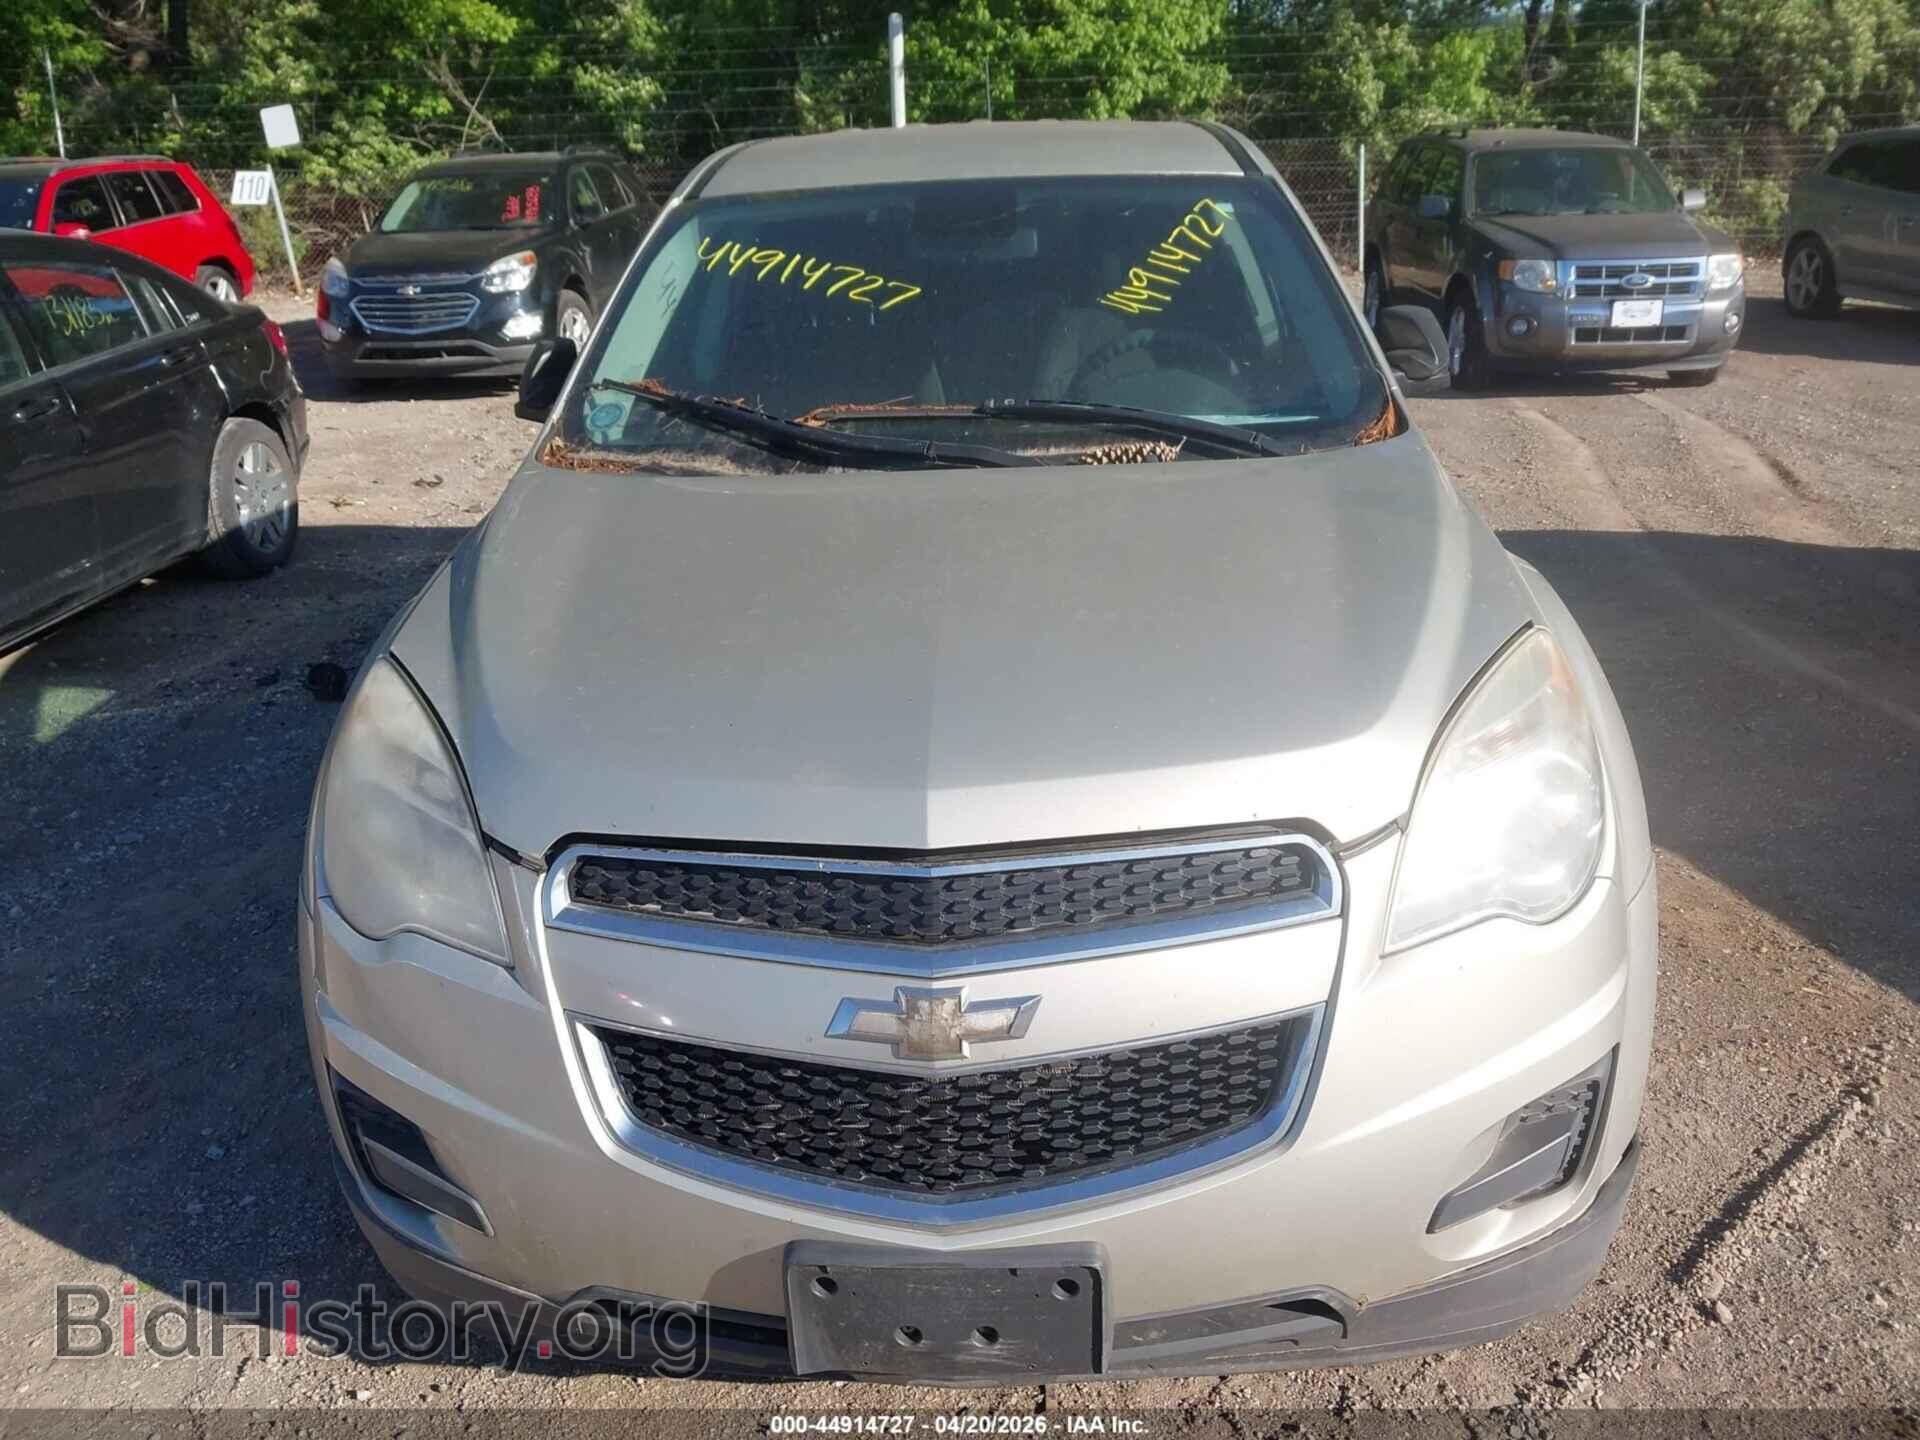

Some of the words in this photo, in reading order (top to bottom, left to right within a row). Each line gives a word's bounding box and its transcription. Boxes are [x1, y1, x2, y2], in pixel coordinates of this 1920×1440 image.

[238, 175, 266, 201] 110
[698, 236, 923, 311] 44914727
[1098, 198, 1232, 314] 44914727
